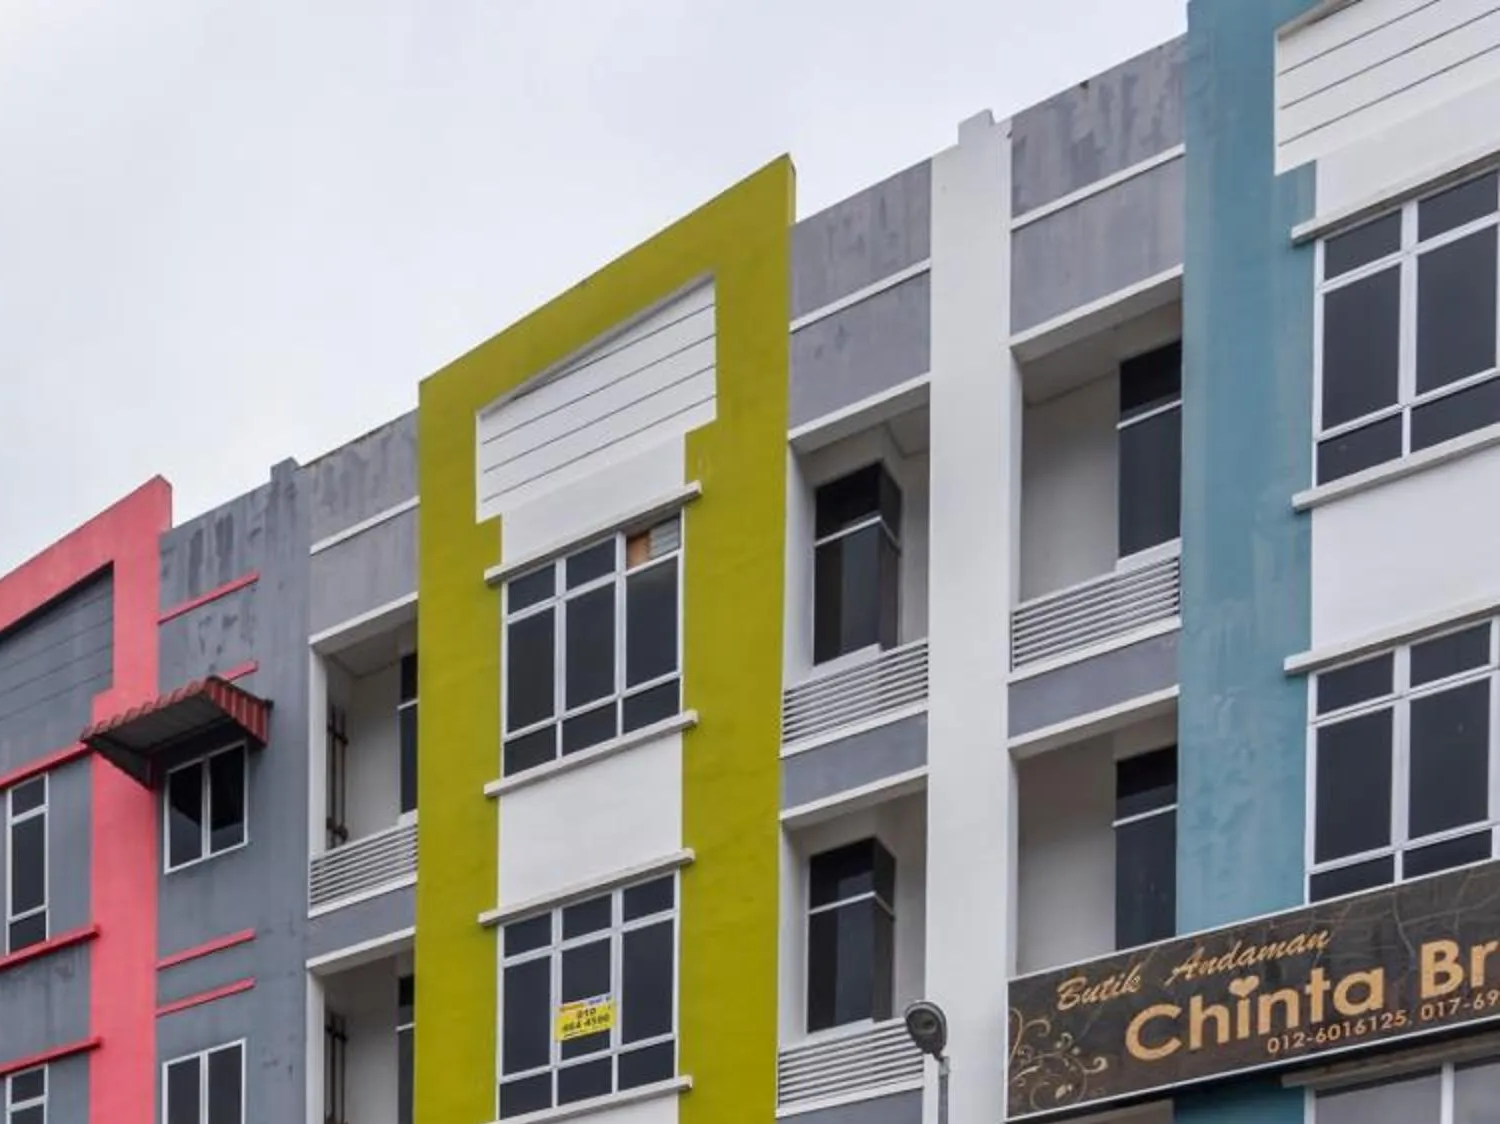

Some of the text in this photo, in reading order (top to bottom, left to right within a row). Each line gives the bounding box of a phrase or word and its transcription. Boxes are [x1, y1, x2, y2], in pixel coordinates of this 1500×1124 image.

[1056, 926, 1332, 1012] Butik Andaman
[1125, 966, 1384, 1063] Chinta
